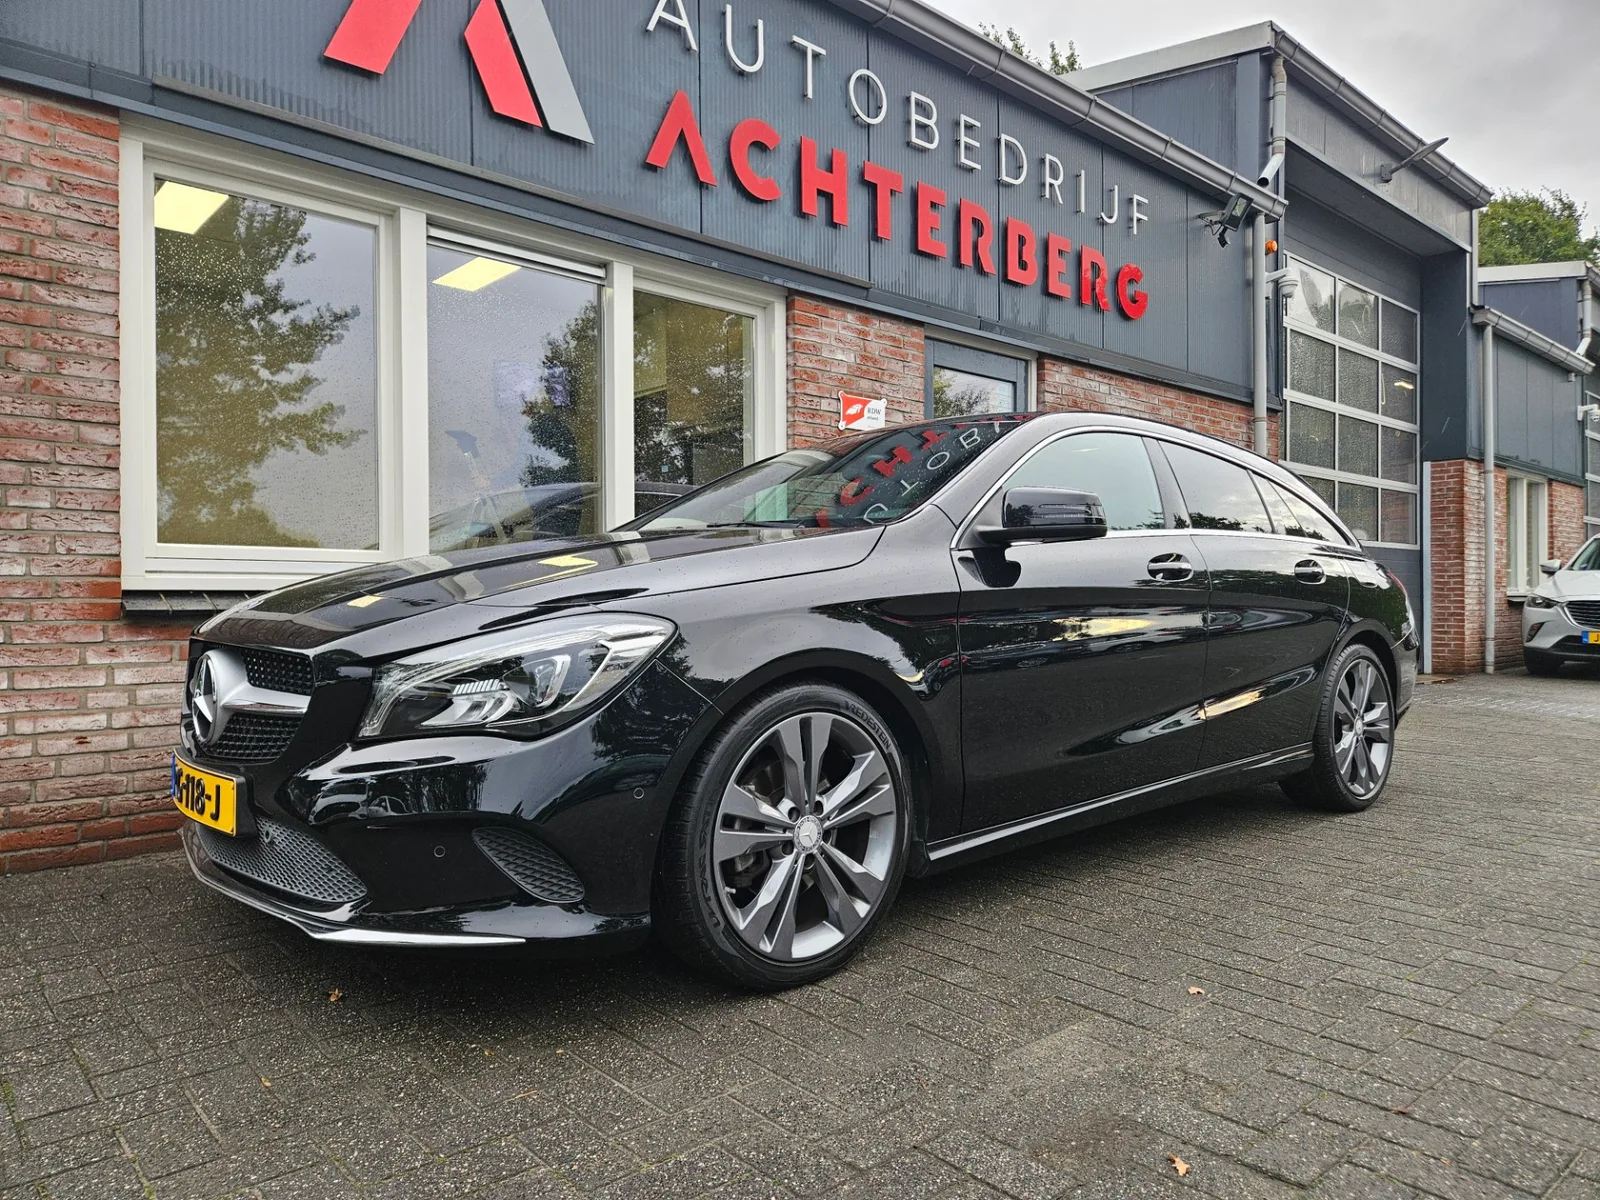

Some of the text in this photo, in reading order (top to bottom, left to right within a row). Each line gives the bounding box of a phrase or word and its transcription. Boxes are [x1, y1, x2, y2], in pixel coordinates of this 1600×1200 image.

[646, 0, 1149, 235] AUTOBEDRIJF
[645, 88, 1149, 320] ACHTERBERG
[174, 765, 221, 822] G-118-J
[844, 700, 892, 750] VREDESTEIN
